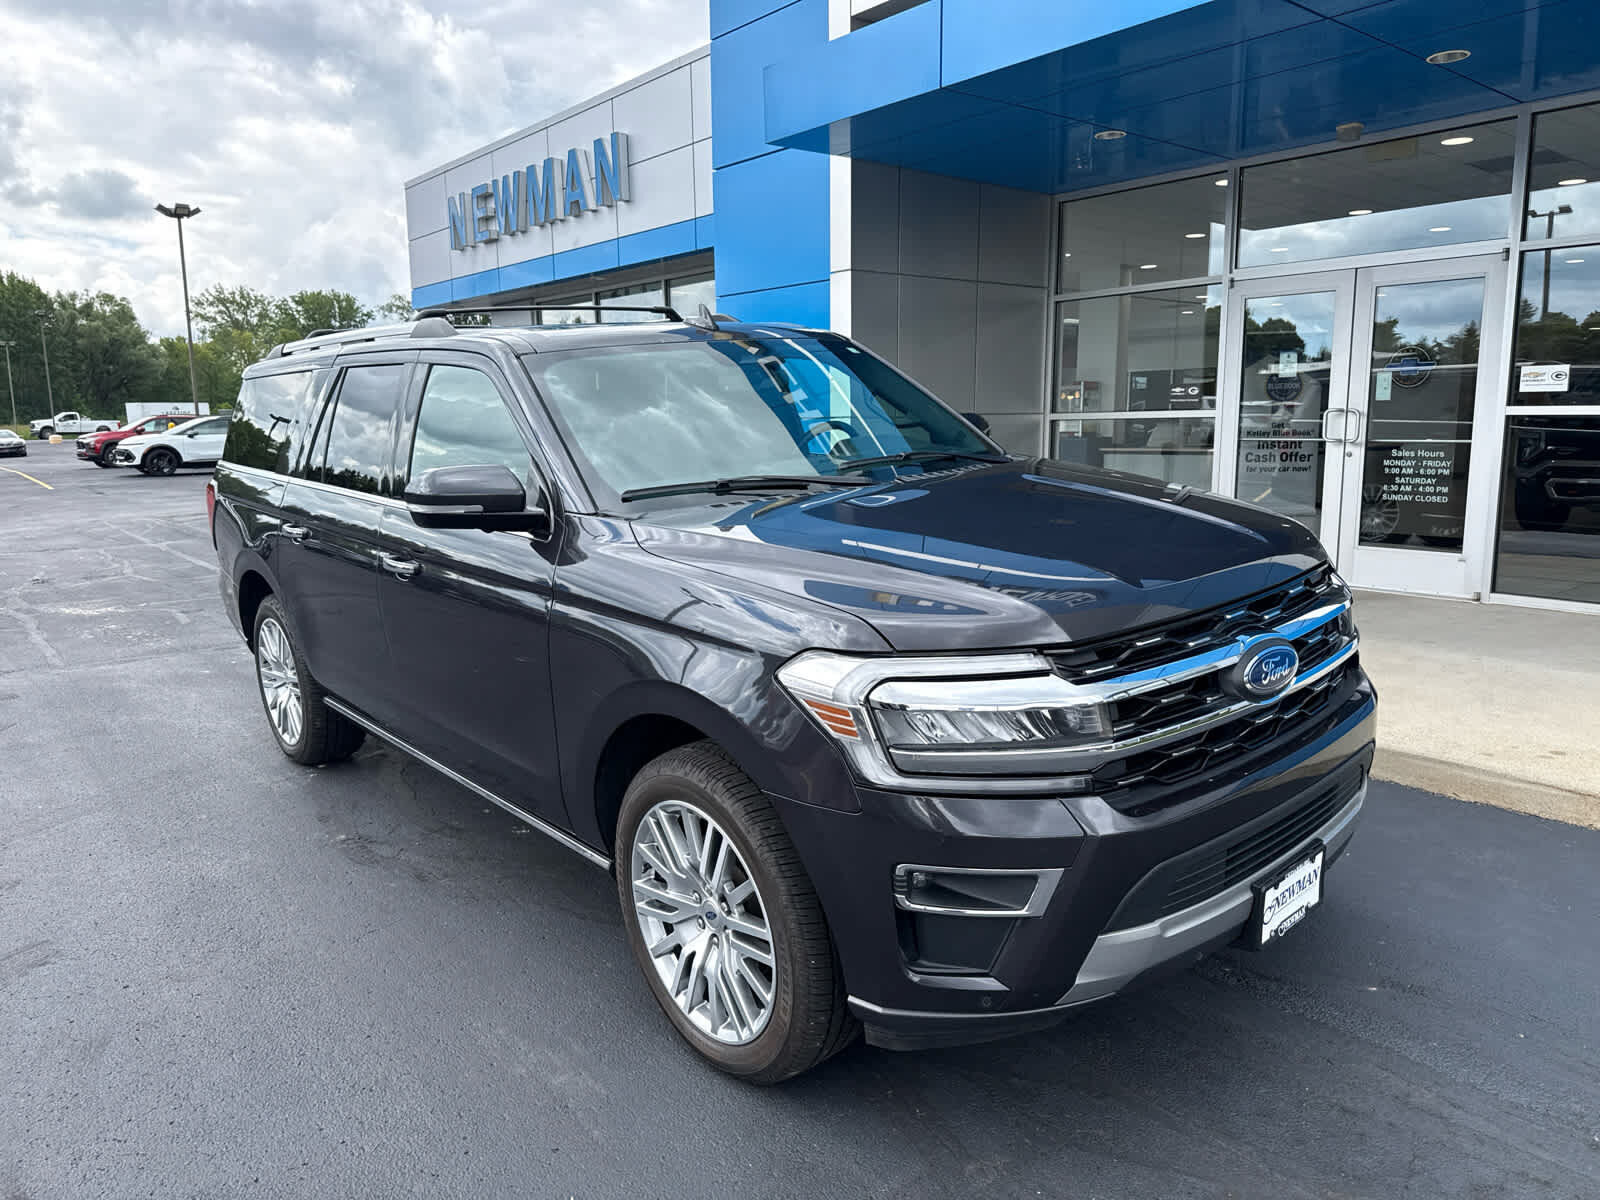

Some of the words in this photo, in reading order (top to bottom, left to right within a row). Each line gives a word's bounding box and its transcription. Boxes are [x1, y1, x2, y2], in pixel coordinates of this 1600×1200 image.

[448, 132, 632, 252] NEWMAN
[1246, 430, 1271, 438] Kelley
[1272, 429, 1290, 437] Blue
[1257, 439, 1303, 449] Instant
[1245, 452, 1276, 463] Cash
[1280, 451, 1314, 463] Offer
[1391, 448, 1416, 457] Sales
[1417, 449, 1445, 458] Hours
[1383, 459, 1417, 467] MONDAY
[1258, 466, 1276, 474] your
[1292, 465, 1312, 473] now!
[1401, 467, 1414, 475] AM
[1437, 468, 1450, 476] PM
[1394, 476, 1437, 485] SATURDAY
[1383, 484, 1399, 492] 8:30
[1436, 486, 1449, 494] PM
[1382, 493, 1414, 501] SUNDAY
[1414, 495, 1449, 503] CLOSED
[1261, 655, 1290, 685] Ford
[1264, 866, 1320, 925] NEWMAN
